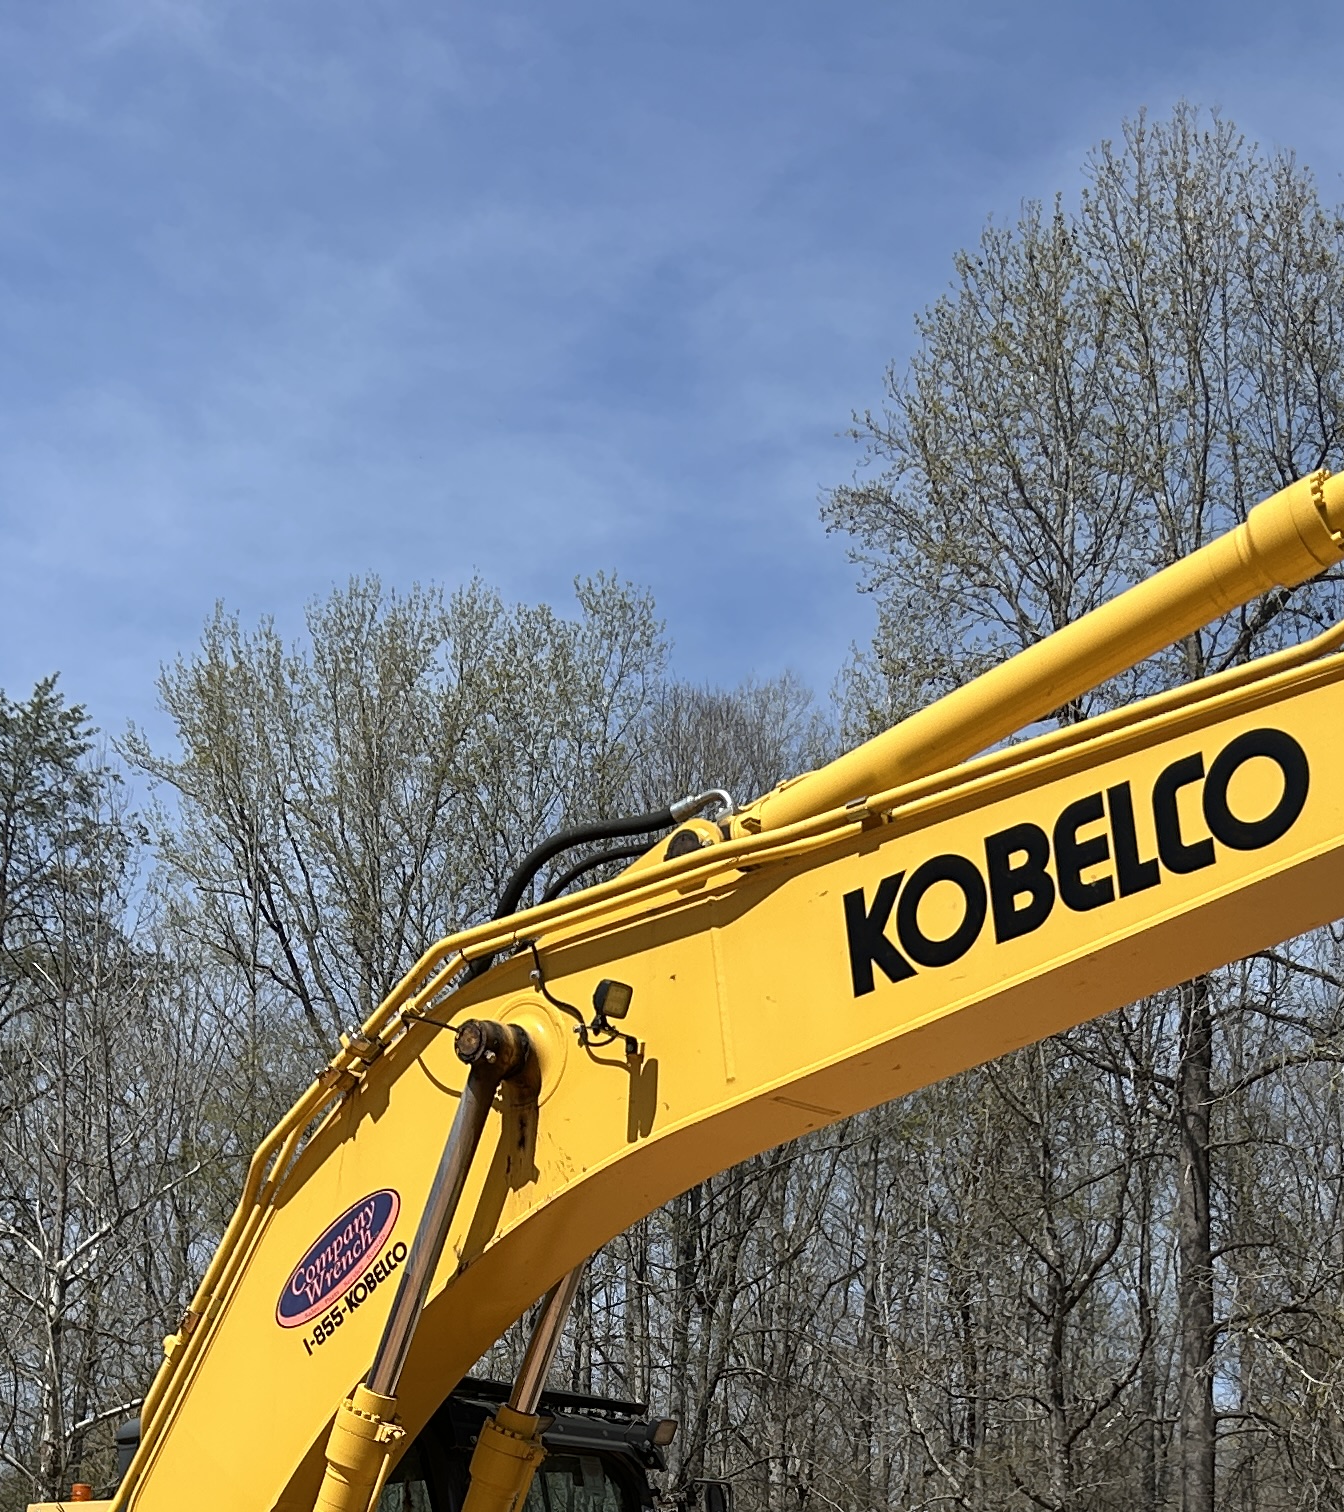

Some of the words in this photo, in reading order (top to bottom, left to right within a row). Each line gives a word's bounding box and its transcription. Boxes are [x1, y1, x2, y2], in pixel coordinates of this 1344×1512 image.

[843, 728, 1310, 998] KOBELCO
[291, 1200, 375, 1296] Company
[302, 1242, 407, 1356] 1-855-KOBELCO
[304, 1229, 373, 1305] Wrench
